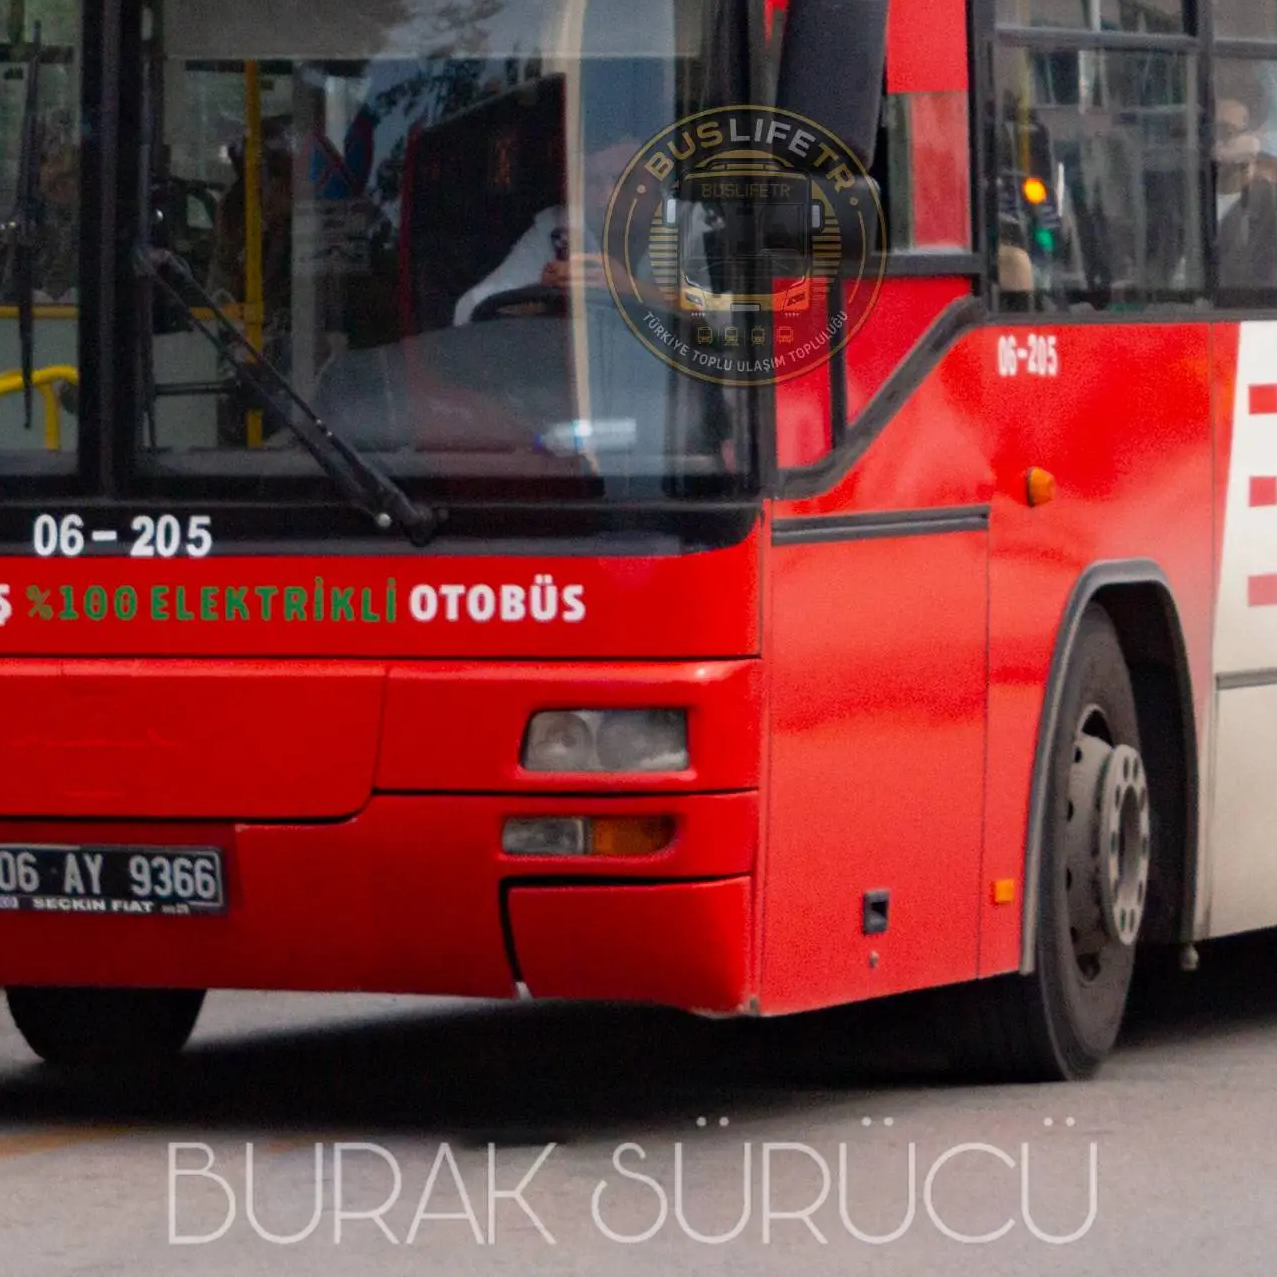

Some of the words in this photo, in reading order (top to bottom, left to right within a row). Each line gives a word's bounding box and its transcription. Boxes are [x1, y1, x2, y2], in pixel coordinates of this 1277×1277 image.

[997, 334, 1058, 377] 06-205
[25, 586, 140, 620] %100
[150, 577, 397, 621] ELEKTRİKLİ
[409, 574, 586, 621] OTOBÜS
[63, 853, 103, 895] AY
[129, 854, 216, 900] 9366
